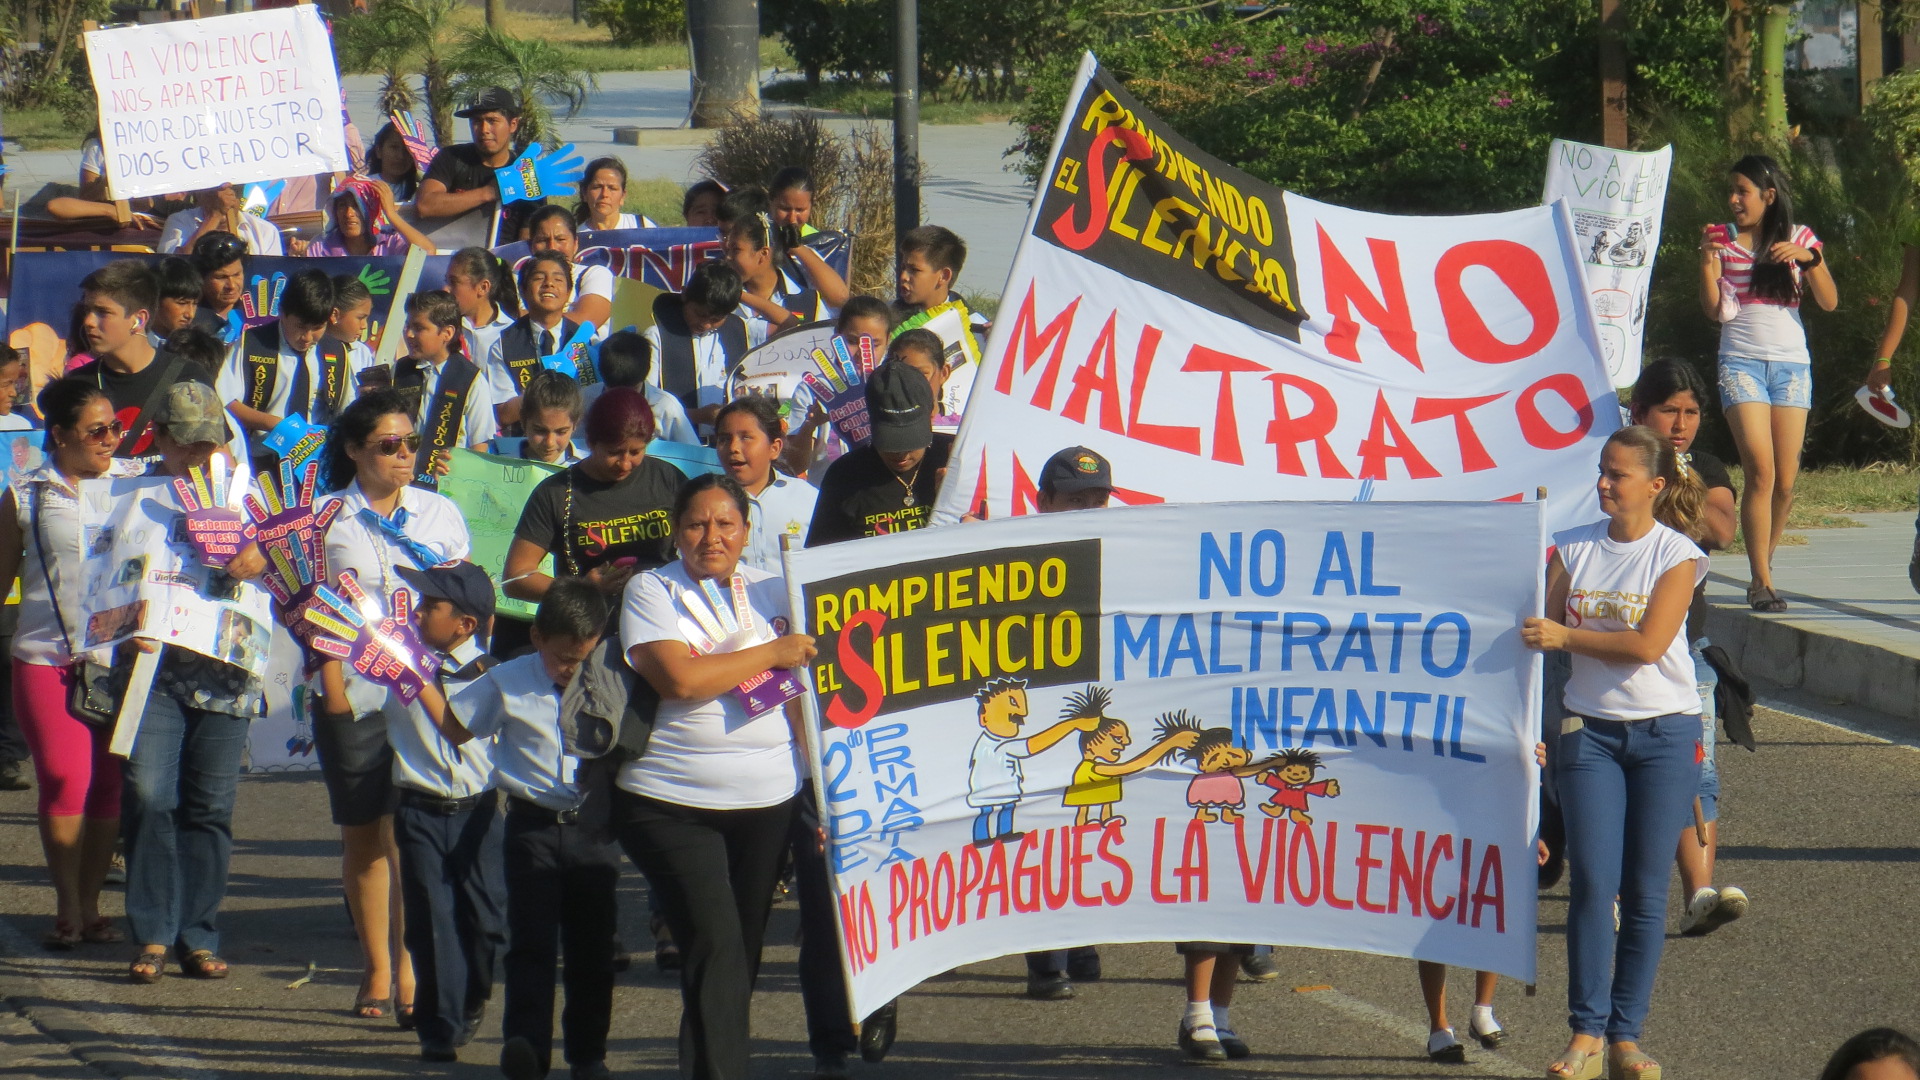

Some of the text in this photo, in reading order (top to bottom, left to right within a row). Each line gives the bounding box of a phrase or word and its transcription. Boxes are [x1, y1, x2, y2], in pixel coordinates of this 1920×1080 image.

[107, 30, 296, 80] LA VIOLENCIA
[112, 67, 303, 113] NOS APARTA DEL
[114, 98, 323, 147] AMOR DE NUESTRO
[118, 132, 314, 178] DIOS CREADOR
[1082, 89, 1272, 246] ROMPIENDO
[1560, 143, 1657, 178] NO A LA
[1052, 126, 1296, 312] EL SILENCIO
[1315, 218, 1560, 373] NO
[994, 277, 1595, 481] MALTRATO
[433, 402, 453, 446] JACINTO
[300, 462, 318, 507] VIOLACIÓN
[503, 465, 526, 484] NO
[188, 518, 243, 532] Acabemos
[195, 532, 240, 544] con esto
[258, 513, 315, 543] Acabemos
[316, 500, 342, 528] GOLPES
[577, 509, 668, 530] ROMPIENDO
[577, 519, 671, 557] EL SILENCIO
[205, 543, 237, 554] Ahora
[1199, 529, 1401, 600] NO AL
[732, 576, 754, 630] VIOLACIÓN
[815, 557, 1068, 636] ROMPIENDO
[816, 609, 1083, 730] EL SILENCIO
[1113, 611, 1472, 682] MALTRATO
[1231, 686, 1487, 764] INFANTIL
[829, 807, 873, 875] DE
[840, 817, 1506, 977] NO PROPAGUES LA VIOLENCIA
